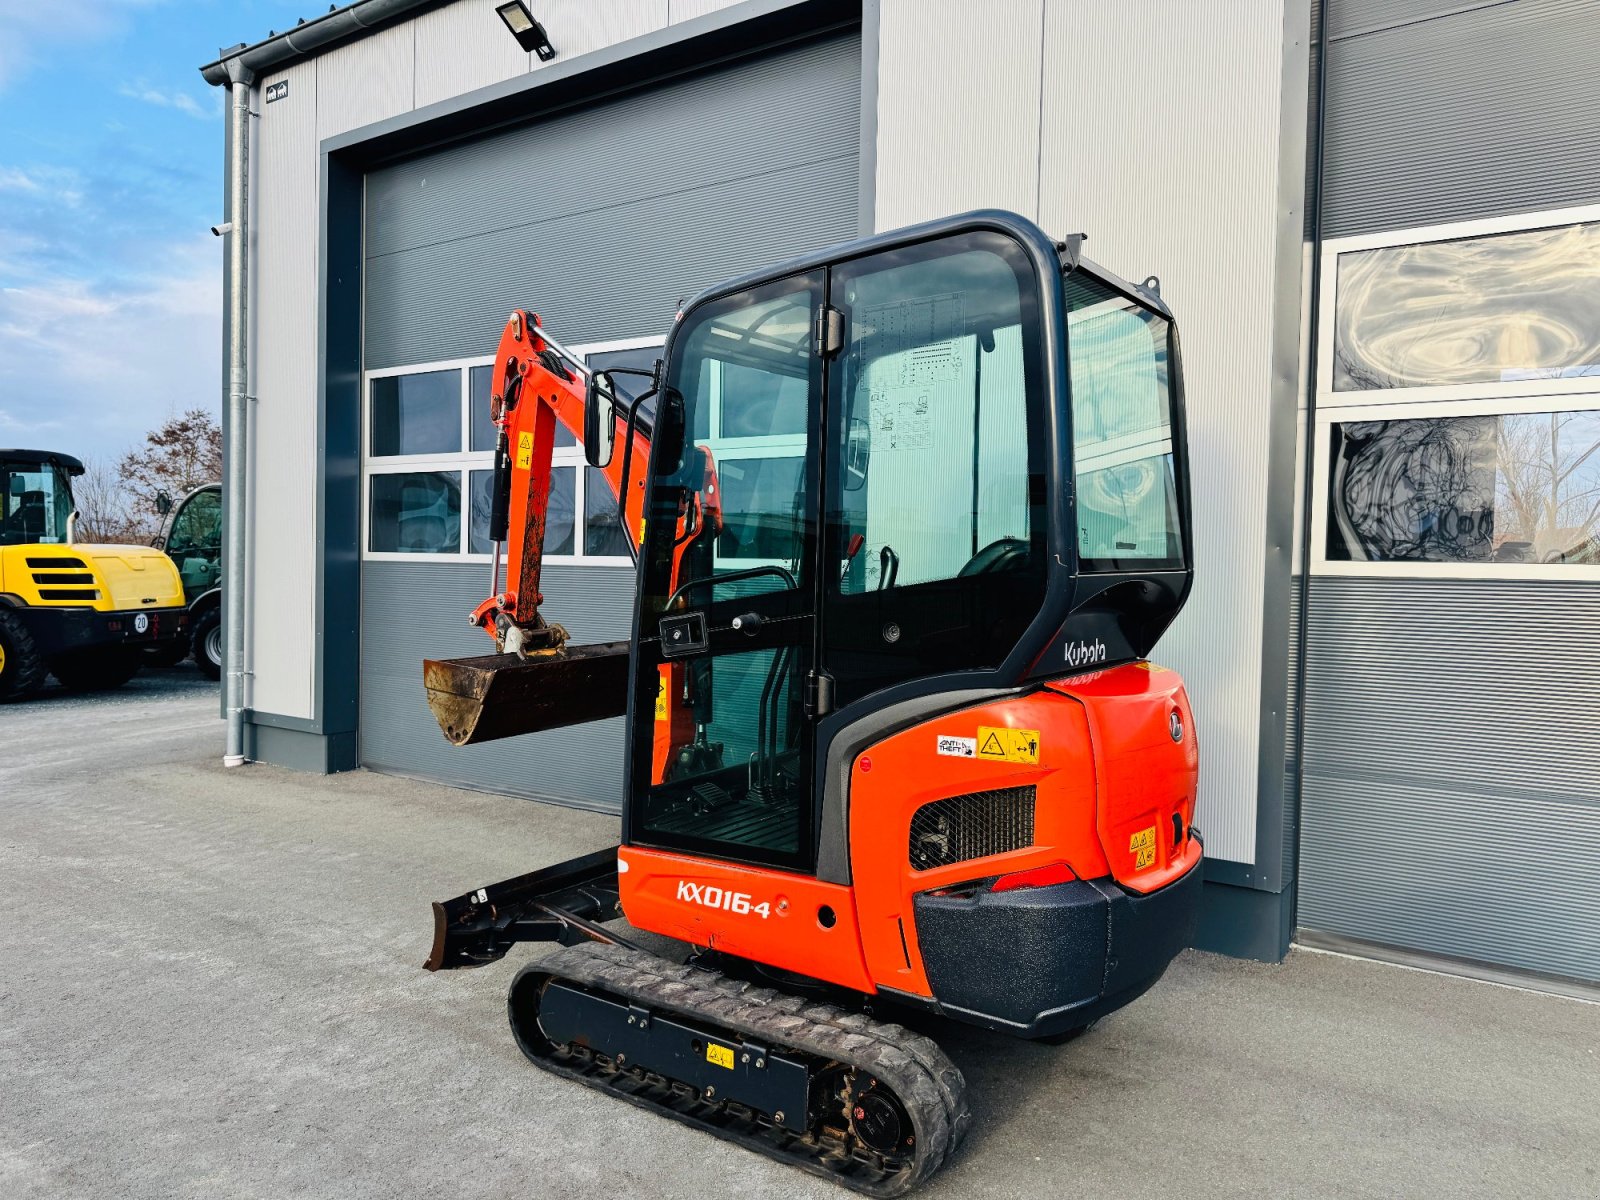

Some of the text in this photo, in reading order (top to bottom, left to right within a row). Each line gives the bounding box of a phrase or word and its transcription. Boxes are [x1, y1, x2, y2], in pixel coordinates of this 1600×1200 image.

[137, 617, 146, 629] 20
[1064, 638, 1106, 666] Kubota
[939, 745, 961, 753] THEFT
[677, 880, 771, 919] KX016-4
